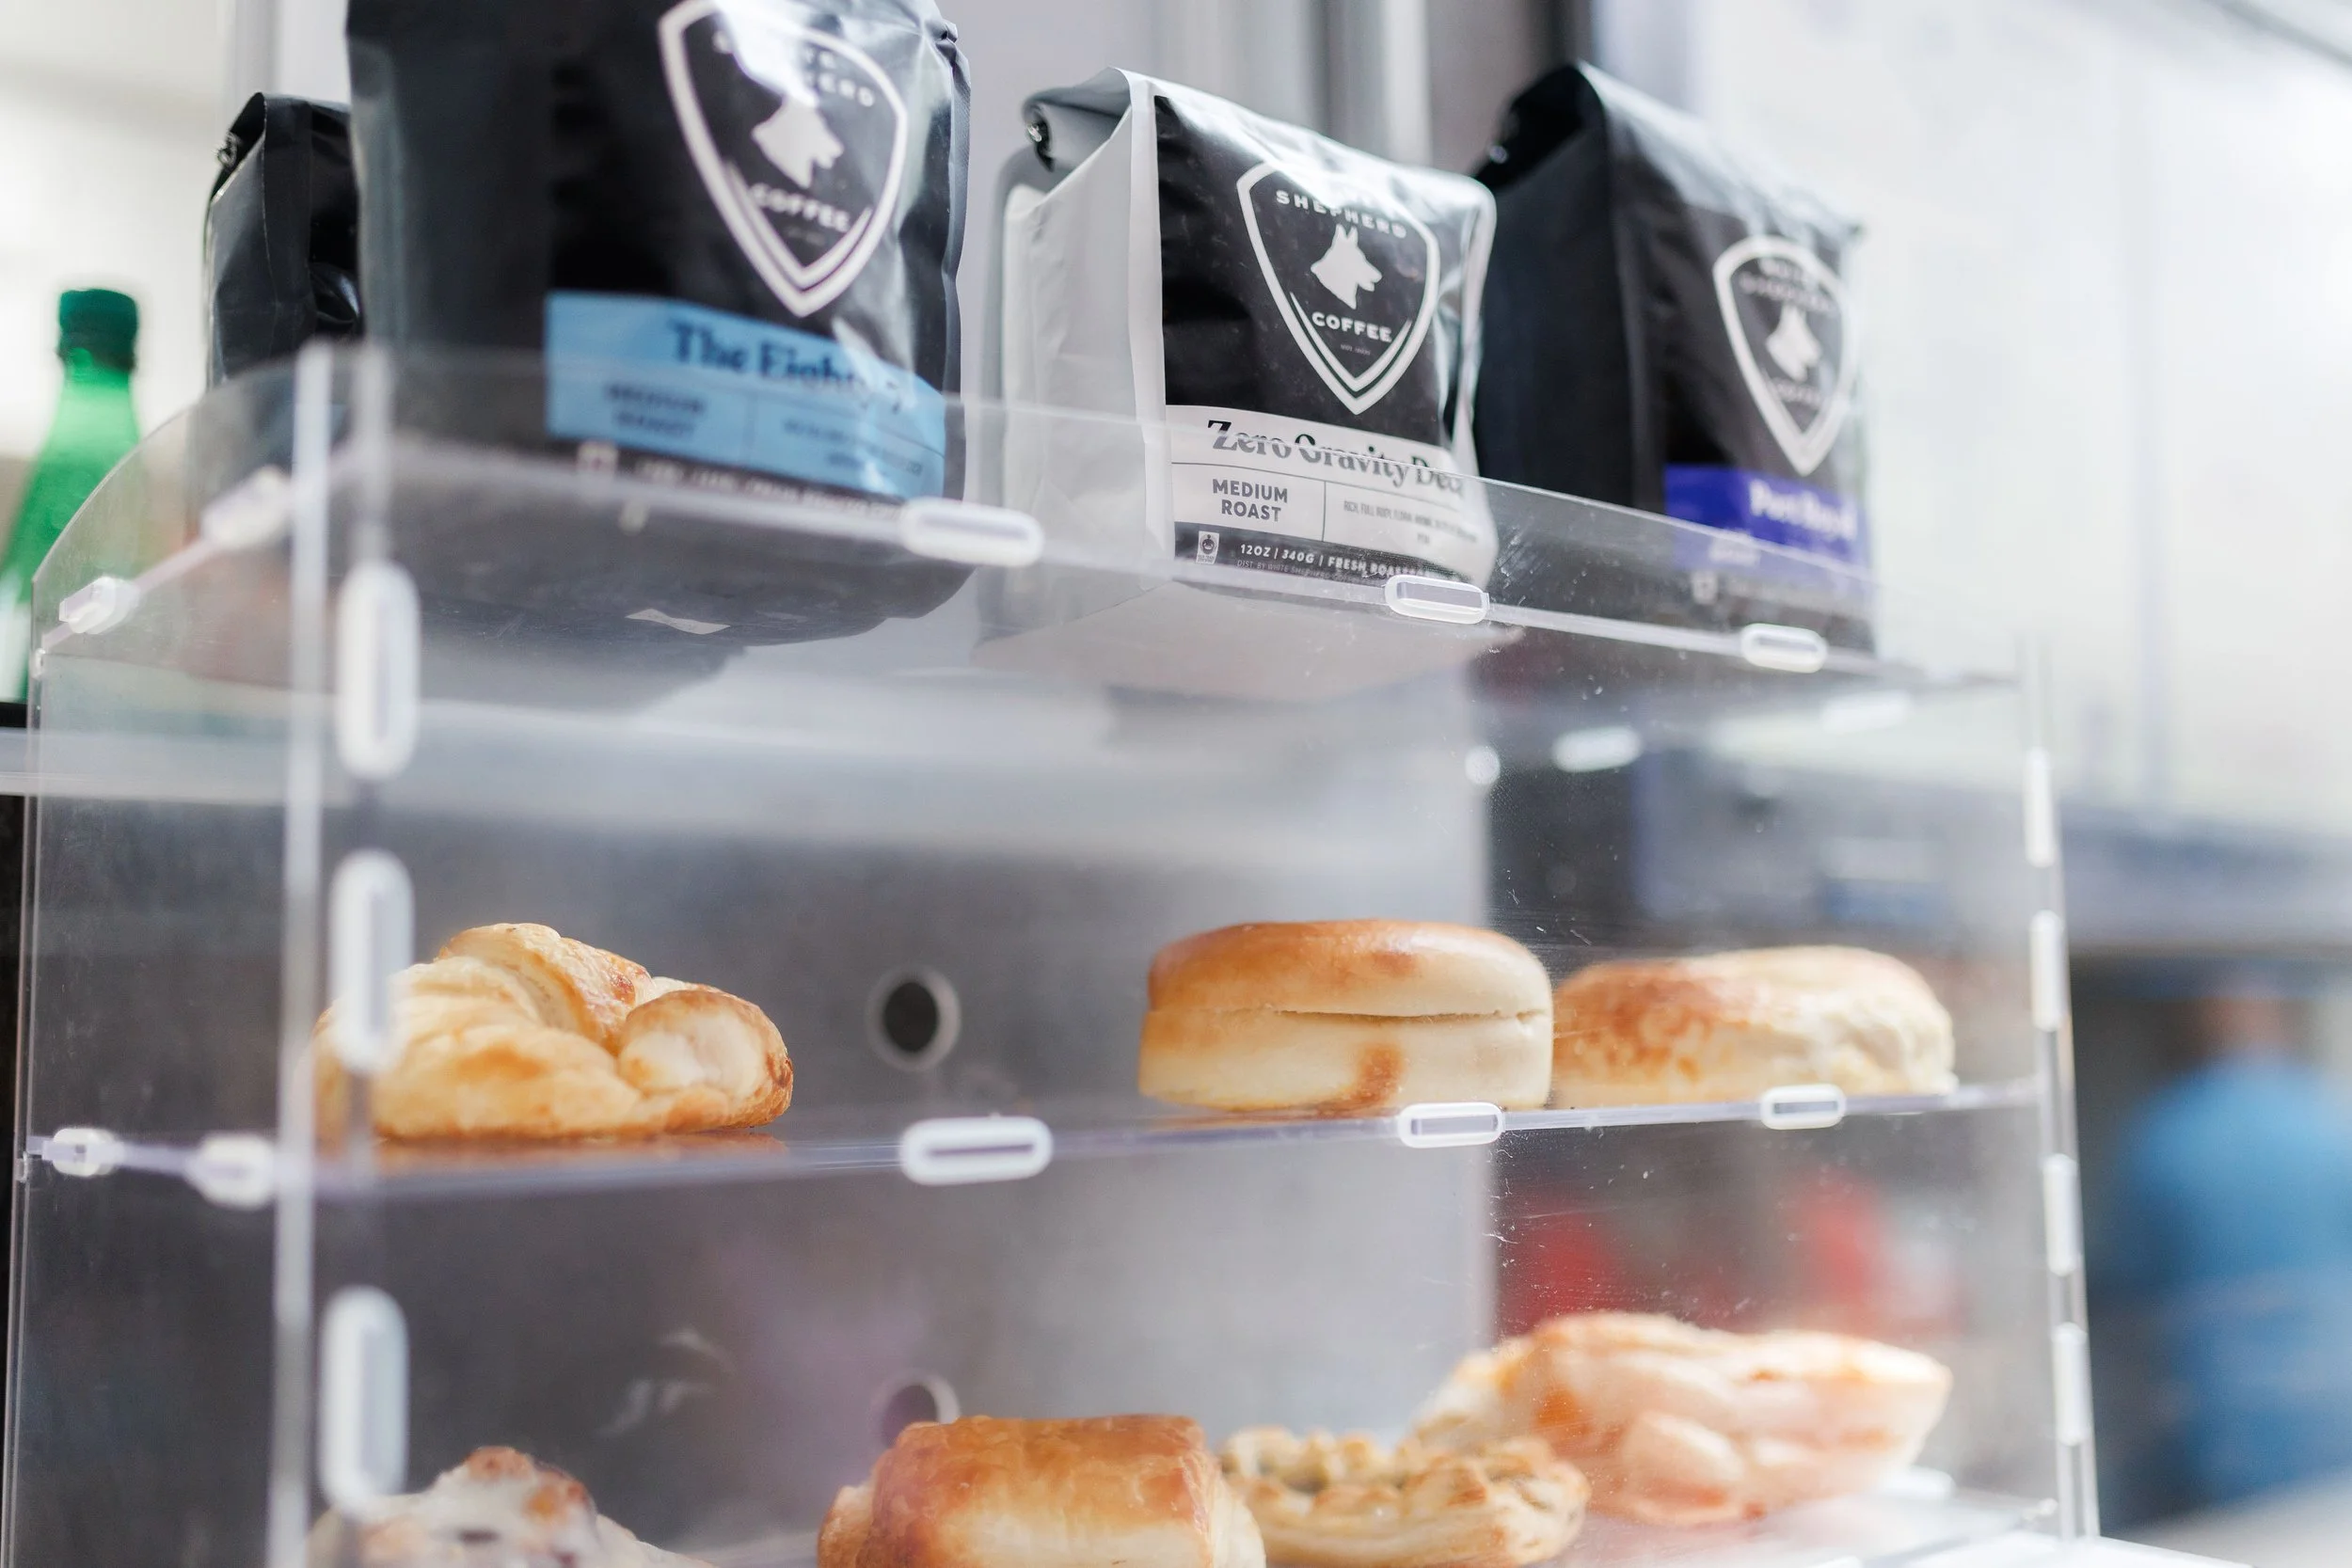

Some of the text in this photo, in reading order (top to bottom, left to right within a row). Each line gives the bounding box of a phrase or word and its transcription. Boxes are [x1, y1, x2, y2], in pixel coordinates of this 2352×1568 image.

[749, 182, 850, 233] COFFEE
[1276, 189, 1407, 240] SHEPHERD
[671, 318, 748, 374] The
[1311, 311, 1392, 343] COFFEE
[1207, 420, 1293, 459] Zero
[1295, 434, 1411, 488] Gravity
[1212, 478, 1288, 503] MEDIUM
[1221, 499, 1281, 522] ROAST
[1240, 544, 1271, 558] 12OZ
[1281, 549, 1315, 564] 340G
[1327, 556, 1367, 573] FRESH
